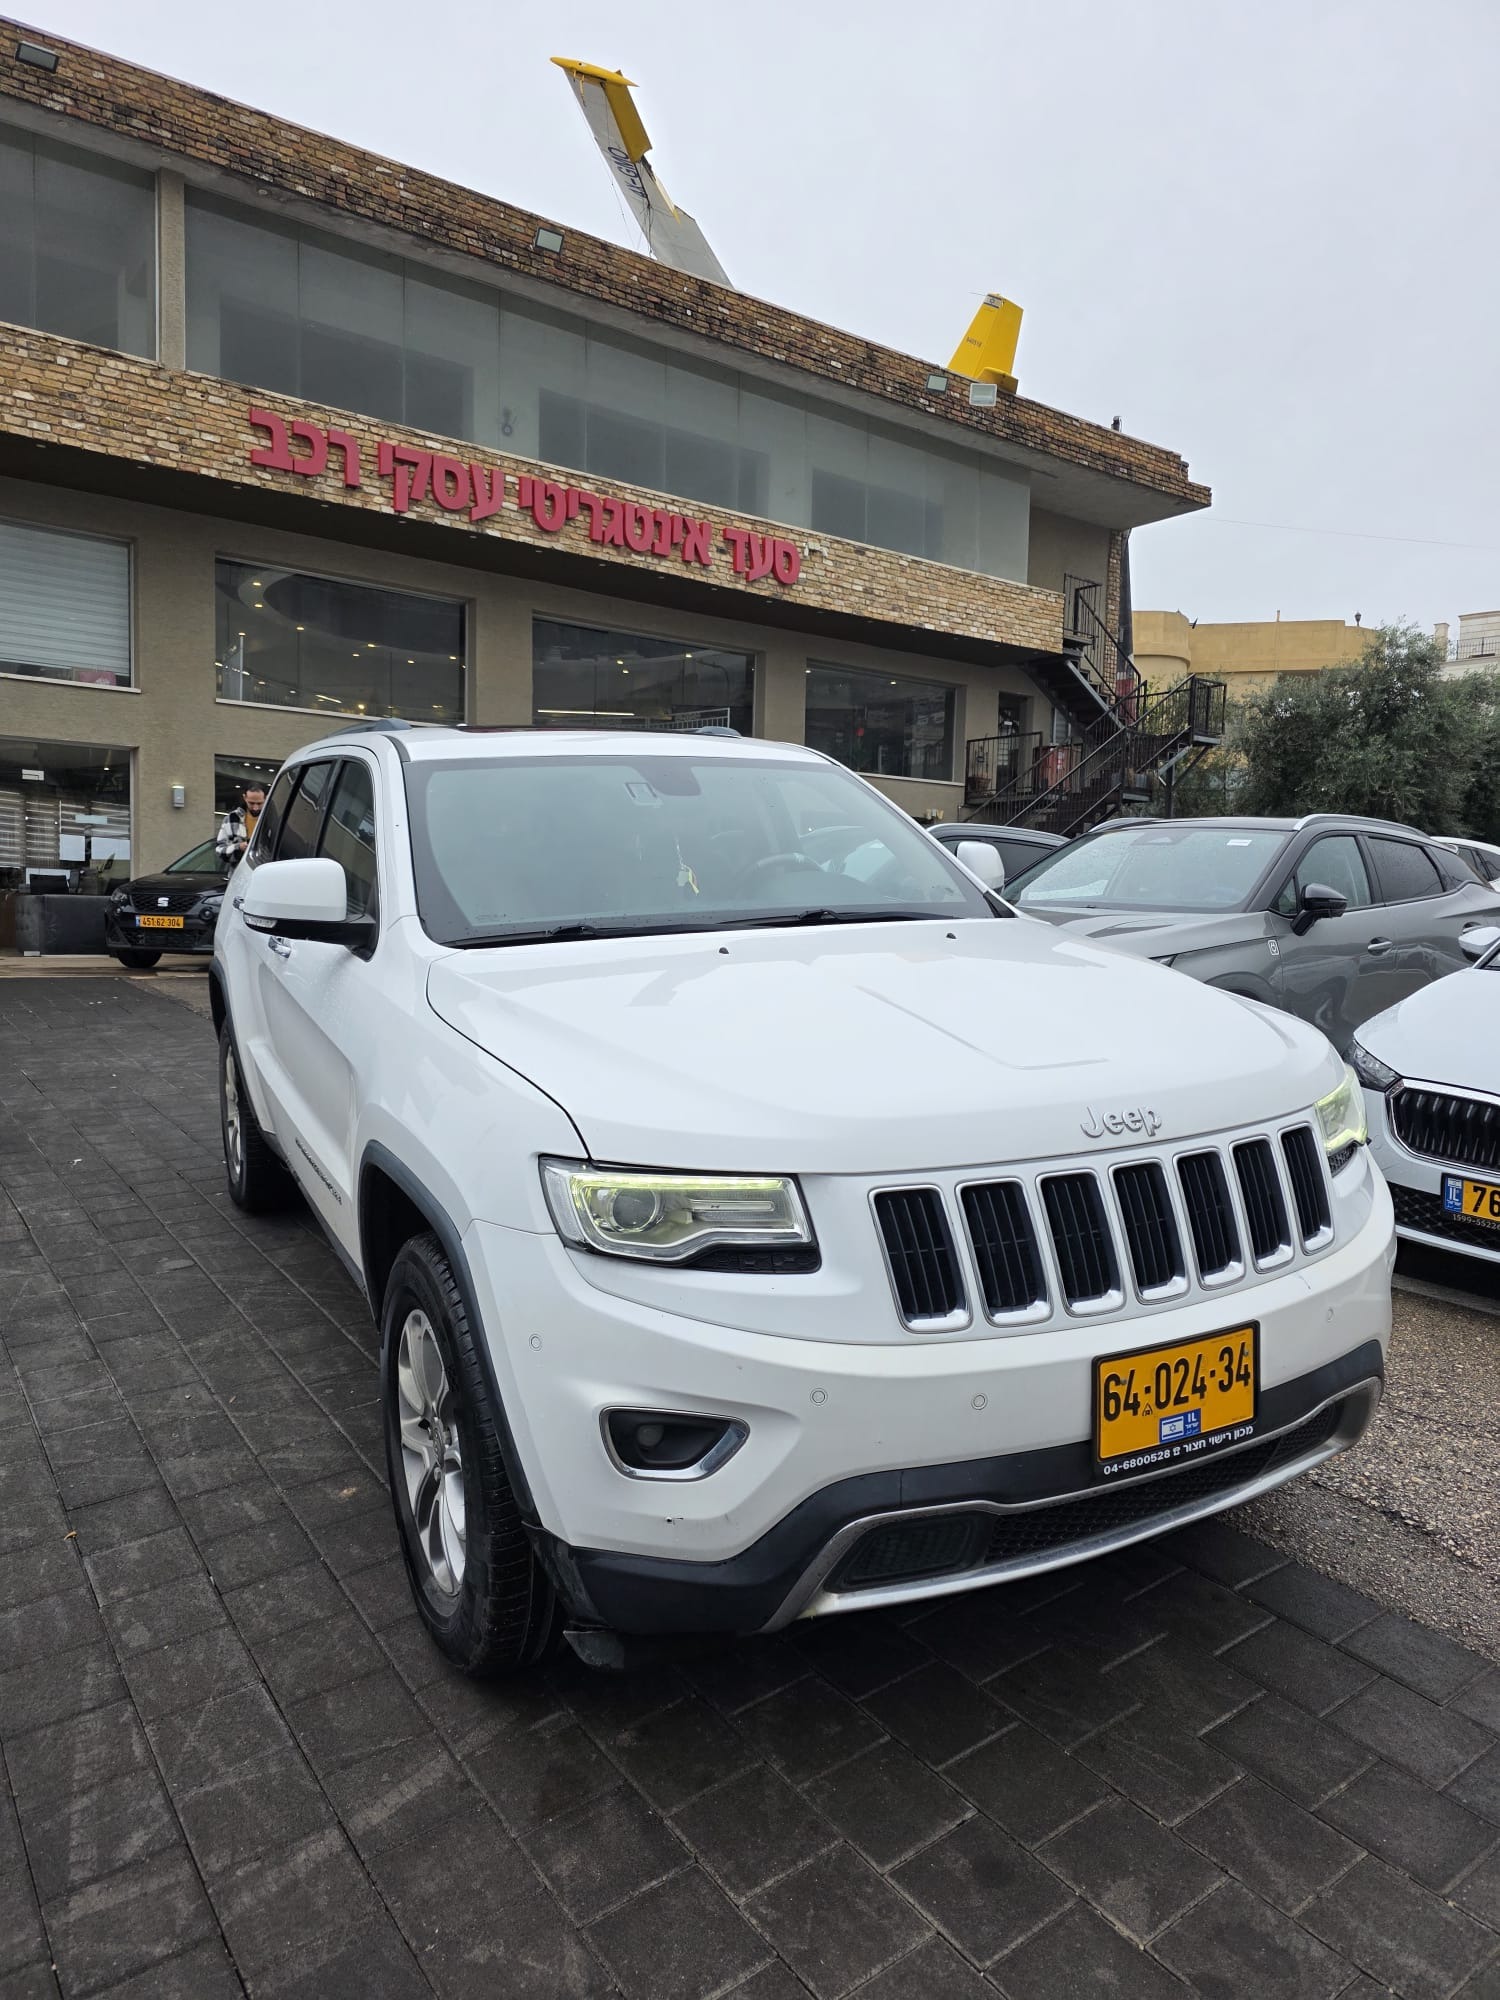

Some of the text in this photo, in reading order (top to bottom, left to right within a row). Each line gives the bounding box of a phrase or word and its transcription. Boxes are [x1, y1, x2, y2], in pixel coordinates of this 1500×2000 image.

[249, 407, 801, 585] סעד אינטגריטי עסקי רכב
[1080, 1104, 1162, 1139] Jeep
[1187, 1412, 1197, 1423] IL
[1234, 1425, 1254, 1441] מכון
[1103, 1451, 1171, 1475] 04-6800528
